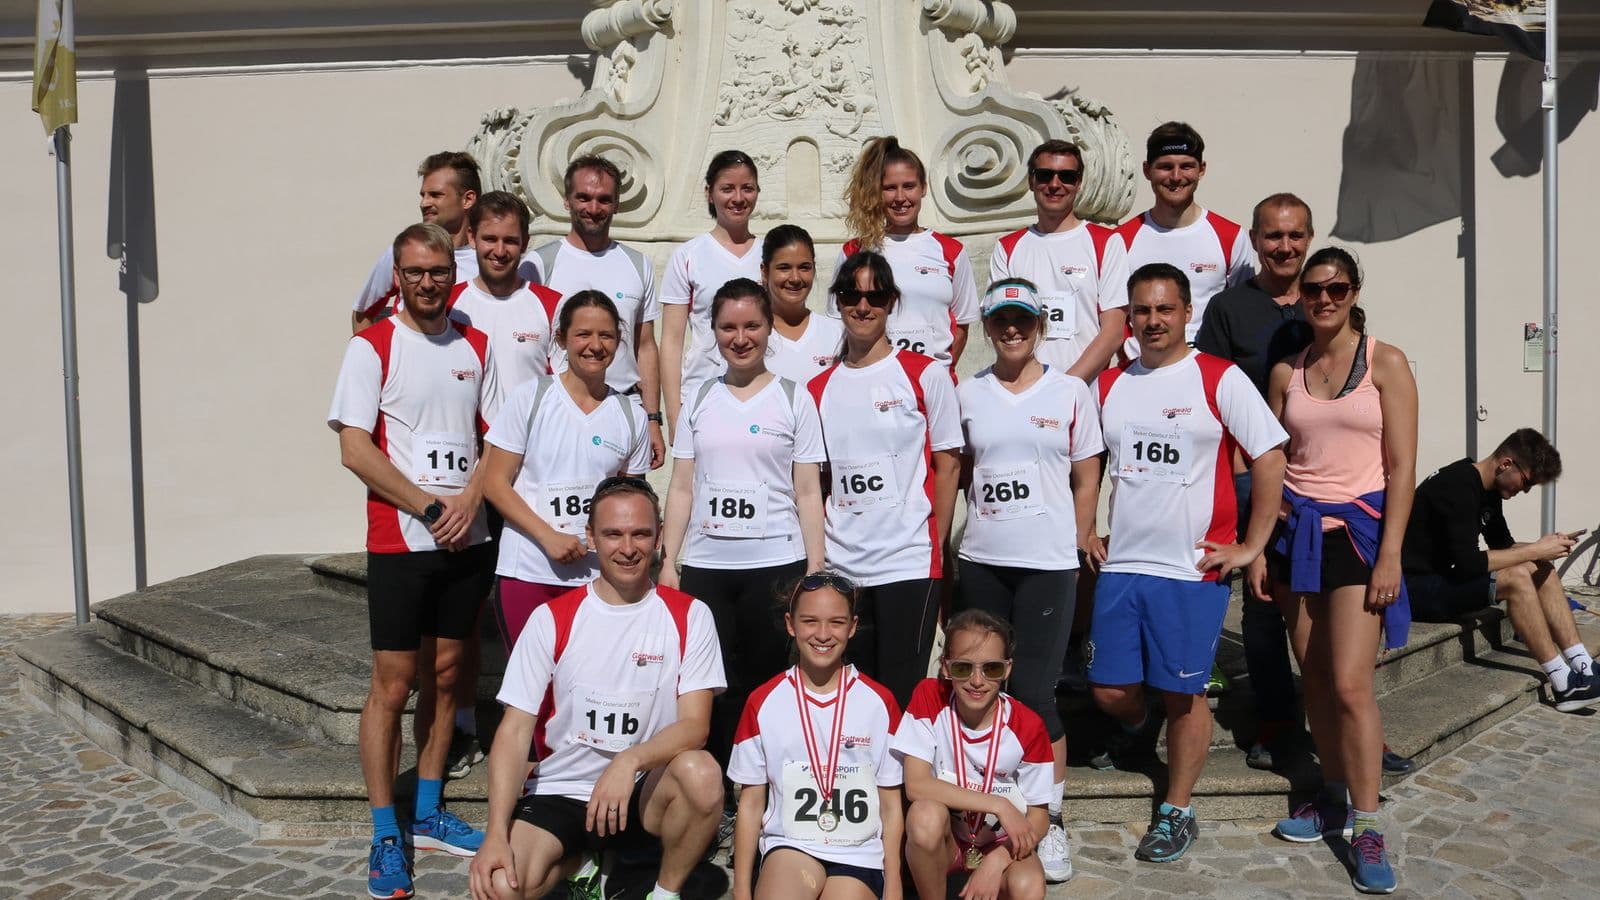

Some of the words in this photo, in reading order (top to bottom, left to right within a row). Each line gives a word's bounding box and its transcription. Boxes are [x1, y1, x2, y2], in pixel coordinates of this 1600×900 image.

[427, 449, 468, 472] 11c
[1133, 440, 1180, 465] 16b
[840, 474, 884, 494] 16c
[982, 480, 1030, 502] 26b
[550, 495, 592, 517] 18a
[709, 497, 755, 519] 18b
[632, 652, 664, 661] Gottwald
[586, 709, 639, 735] 11b
[794, 787, 869, 824] 246
